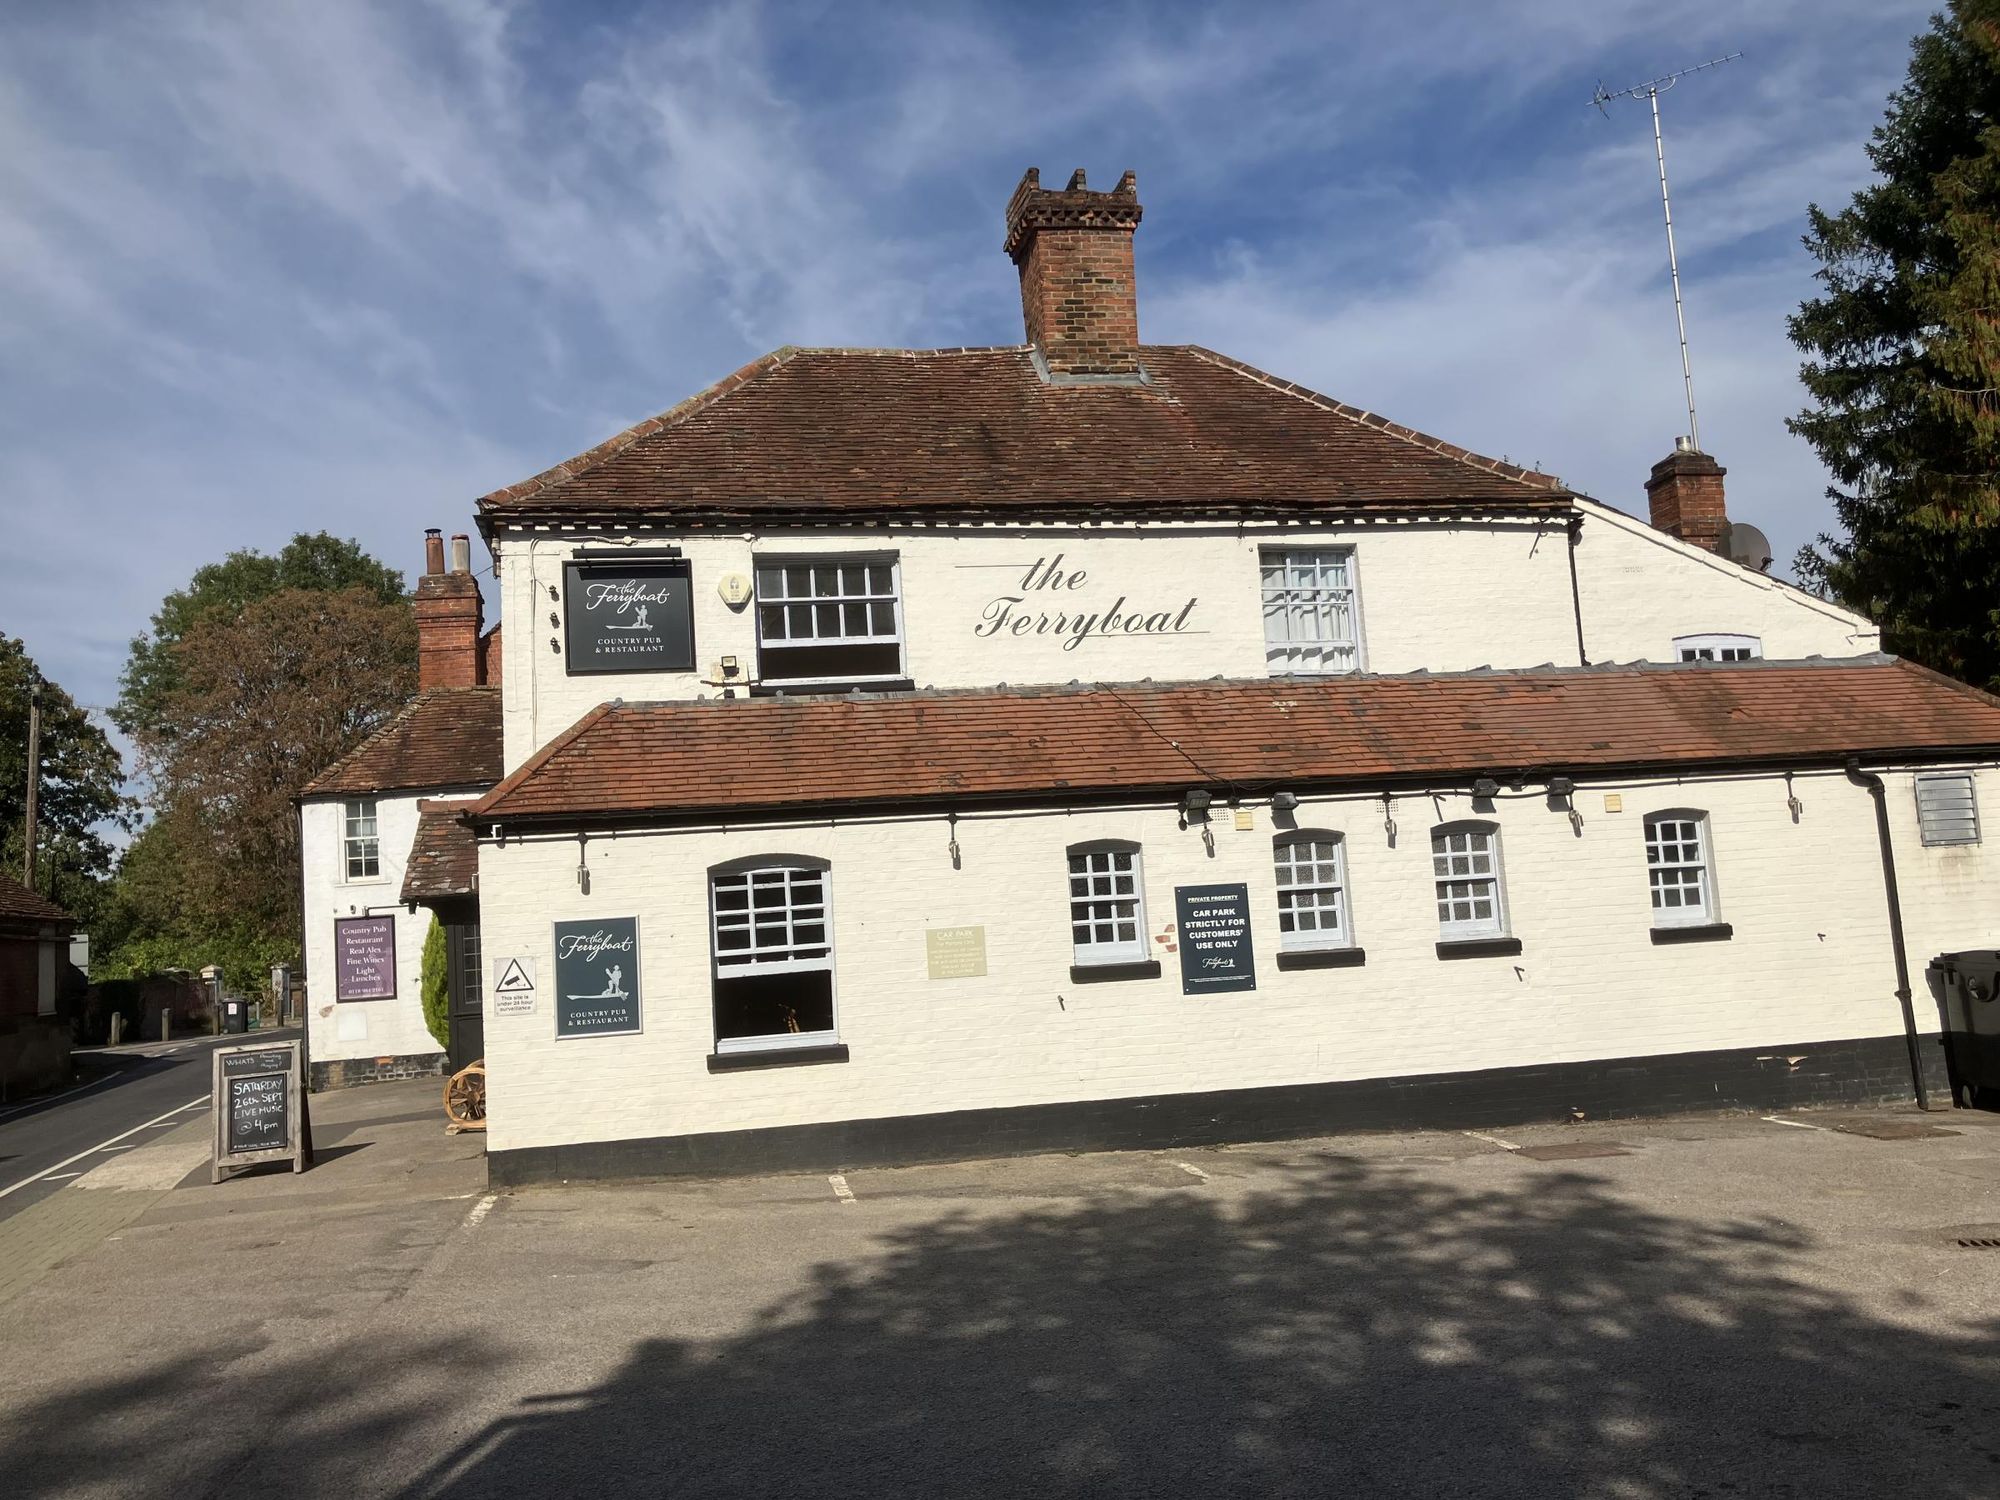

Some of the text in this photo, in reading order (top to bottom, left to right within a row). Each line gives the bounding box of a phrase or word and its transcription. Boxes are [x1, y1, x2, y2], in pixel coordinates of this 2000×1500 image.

[616, 579, 636, 594] the
[586, 583, 670, 614] Ferryboat
[974, 596, 1210, 651] Ferryboat
[597, 636, 661, 645] COUNTRY PUB
[605, 645, 664, 653] RESTAURANT
[1193, 908, 1236, 917] CAR PARK
[1185, 918, 1245, 929] STRICTLY FOR
[342, 927, 371, 935] Country
[1189, 929, 1243, 939] CUSTOMERS'
[346, 937, 383, 945] Restaurant
[585, 930, 603, 944] the
[559, 933, 633, 962] Ferryboat
[1215, 940, 1238, 948] ONLY
[349, 947, 365, 955] Real
[363, 956, 385, 964] Wines
[356, 967, 375, 976] Light
[570, 1010, 608, 1019] COUNTRY
[577, 1016, 629, 1026] RESTAURANT
[234, 1080, 282, 1095] SATURDAY
[261, 1092, 283, 1103] SEPT
[234, 1108, 257, 1119] LIVE
